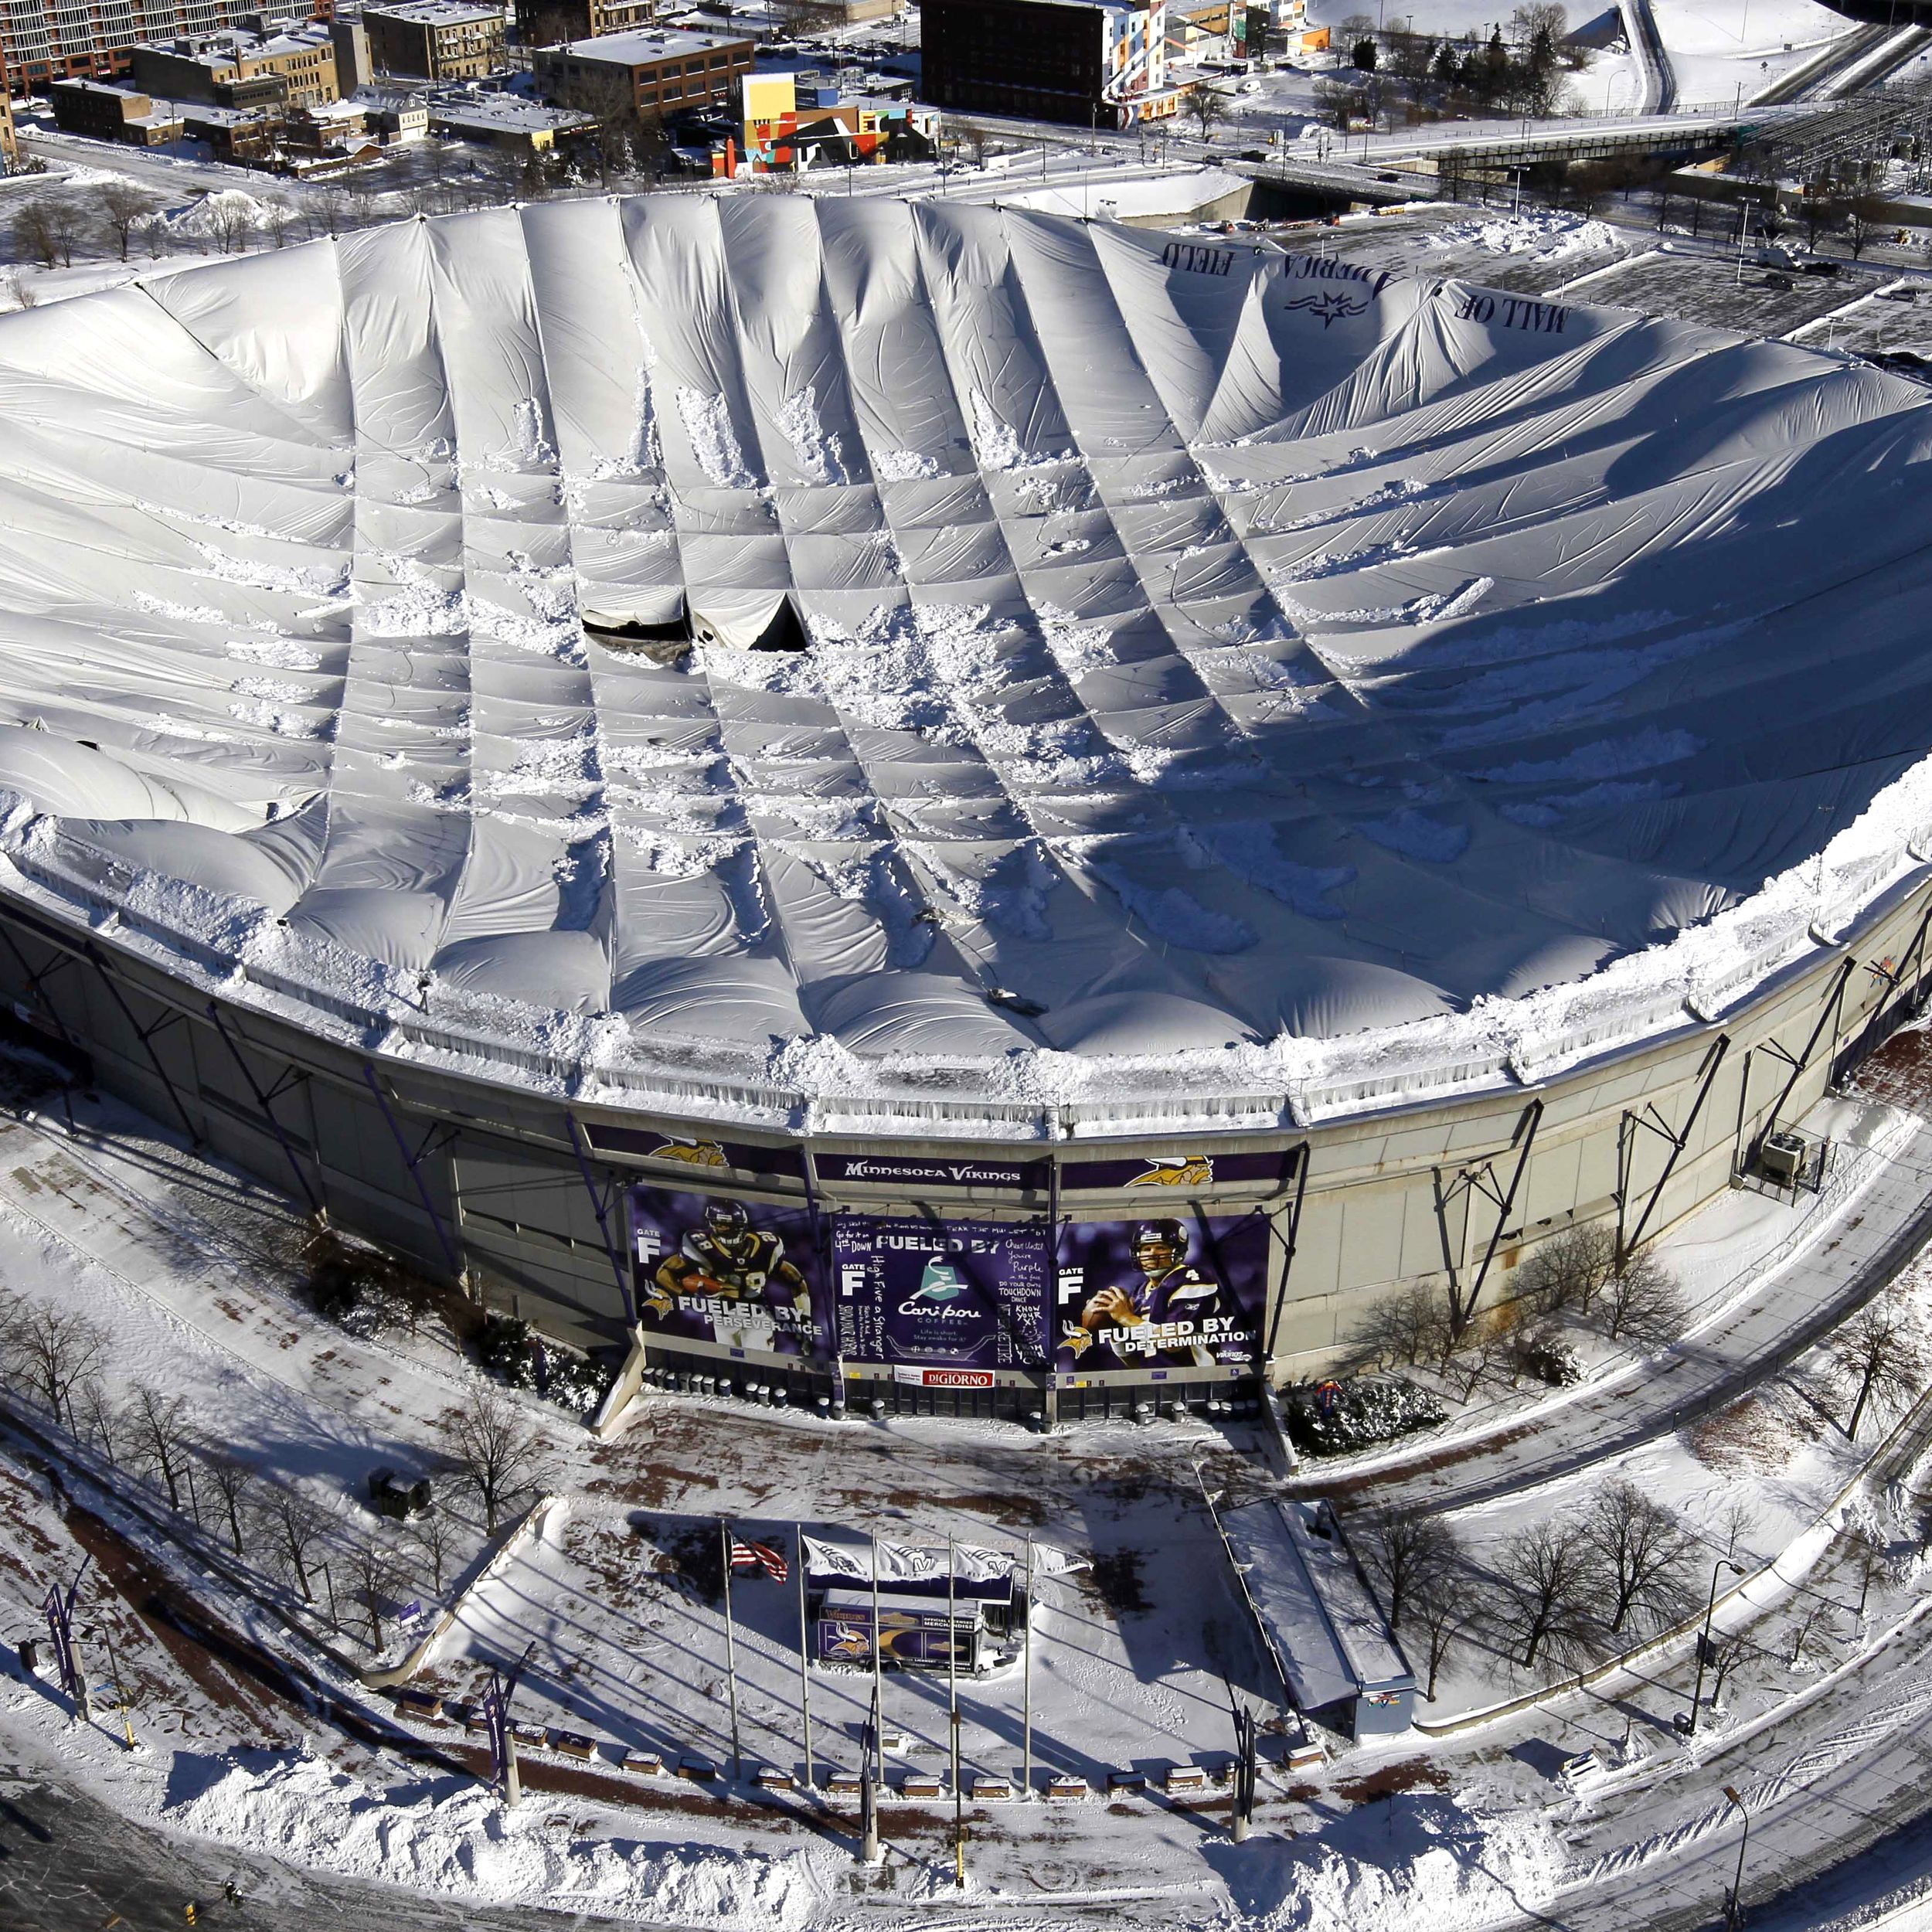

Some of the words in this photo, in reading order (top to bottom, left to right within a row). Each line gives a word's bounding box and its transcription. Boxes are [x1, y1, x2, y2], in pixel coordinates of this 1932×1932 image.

[1162, 243, 1236, 277] FIELD
[1454, 294, 1496, 323] OF
[1502, 299, 1575, 334] MALL
[637, 1228, 660, 1237] GATE
[637, 1237, 661, 1264] F
[876, 1235, 963, 1253] FUELED
[971, 1240, 1000, 1254] BY
[866, 1255, 886, 1277] High
[1013, 1261, 1043, 1273] Purple
[1185, 1269, 1199, 1281] 4
[842, 1271, 866, 1296] F
[873, 1281, 886, 1302] Five
[998, 1287, 1041, 1297] TOUCHDOWN
[1058, 1276, 1083, 1305] F
[678, 1296, 767, 1318] FUELED
[775, 1305, 804, 1322] BY
[875, 1305, 881, 1314] a
[898, 1301, 982, 1319] Caribou
[1016, 1311, 1043, 1321] YOUR
[704, 1315, 823, 1335] PERSEVERANCE
[917, 1317, 962, 1325] COFFEE
[1098, 1320, 1195, 1344] FUELED
[1202, 1316, 1236, 1333] BY
[869, 1316, 886, 1359] Stranger
[1125, 1329, 1256, 1352] DETERMINATION
